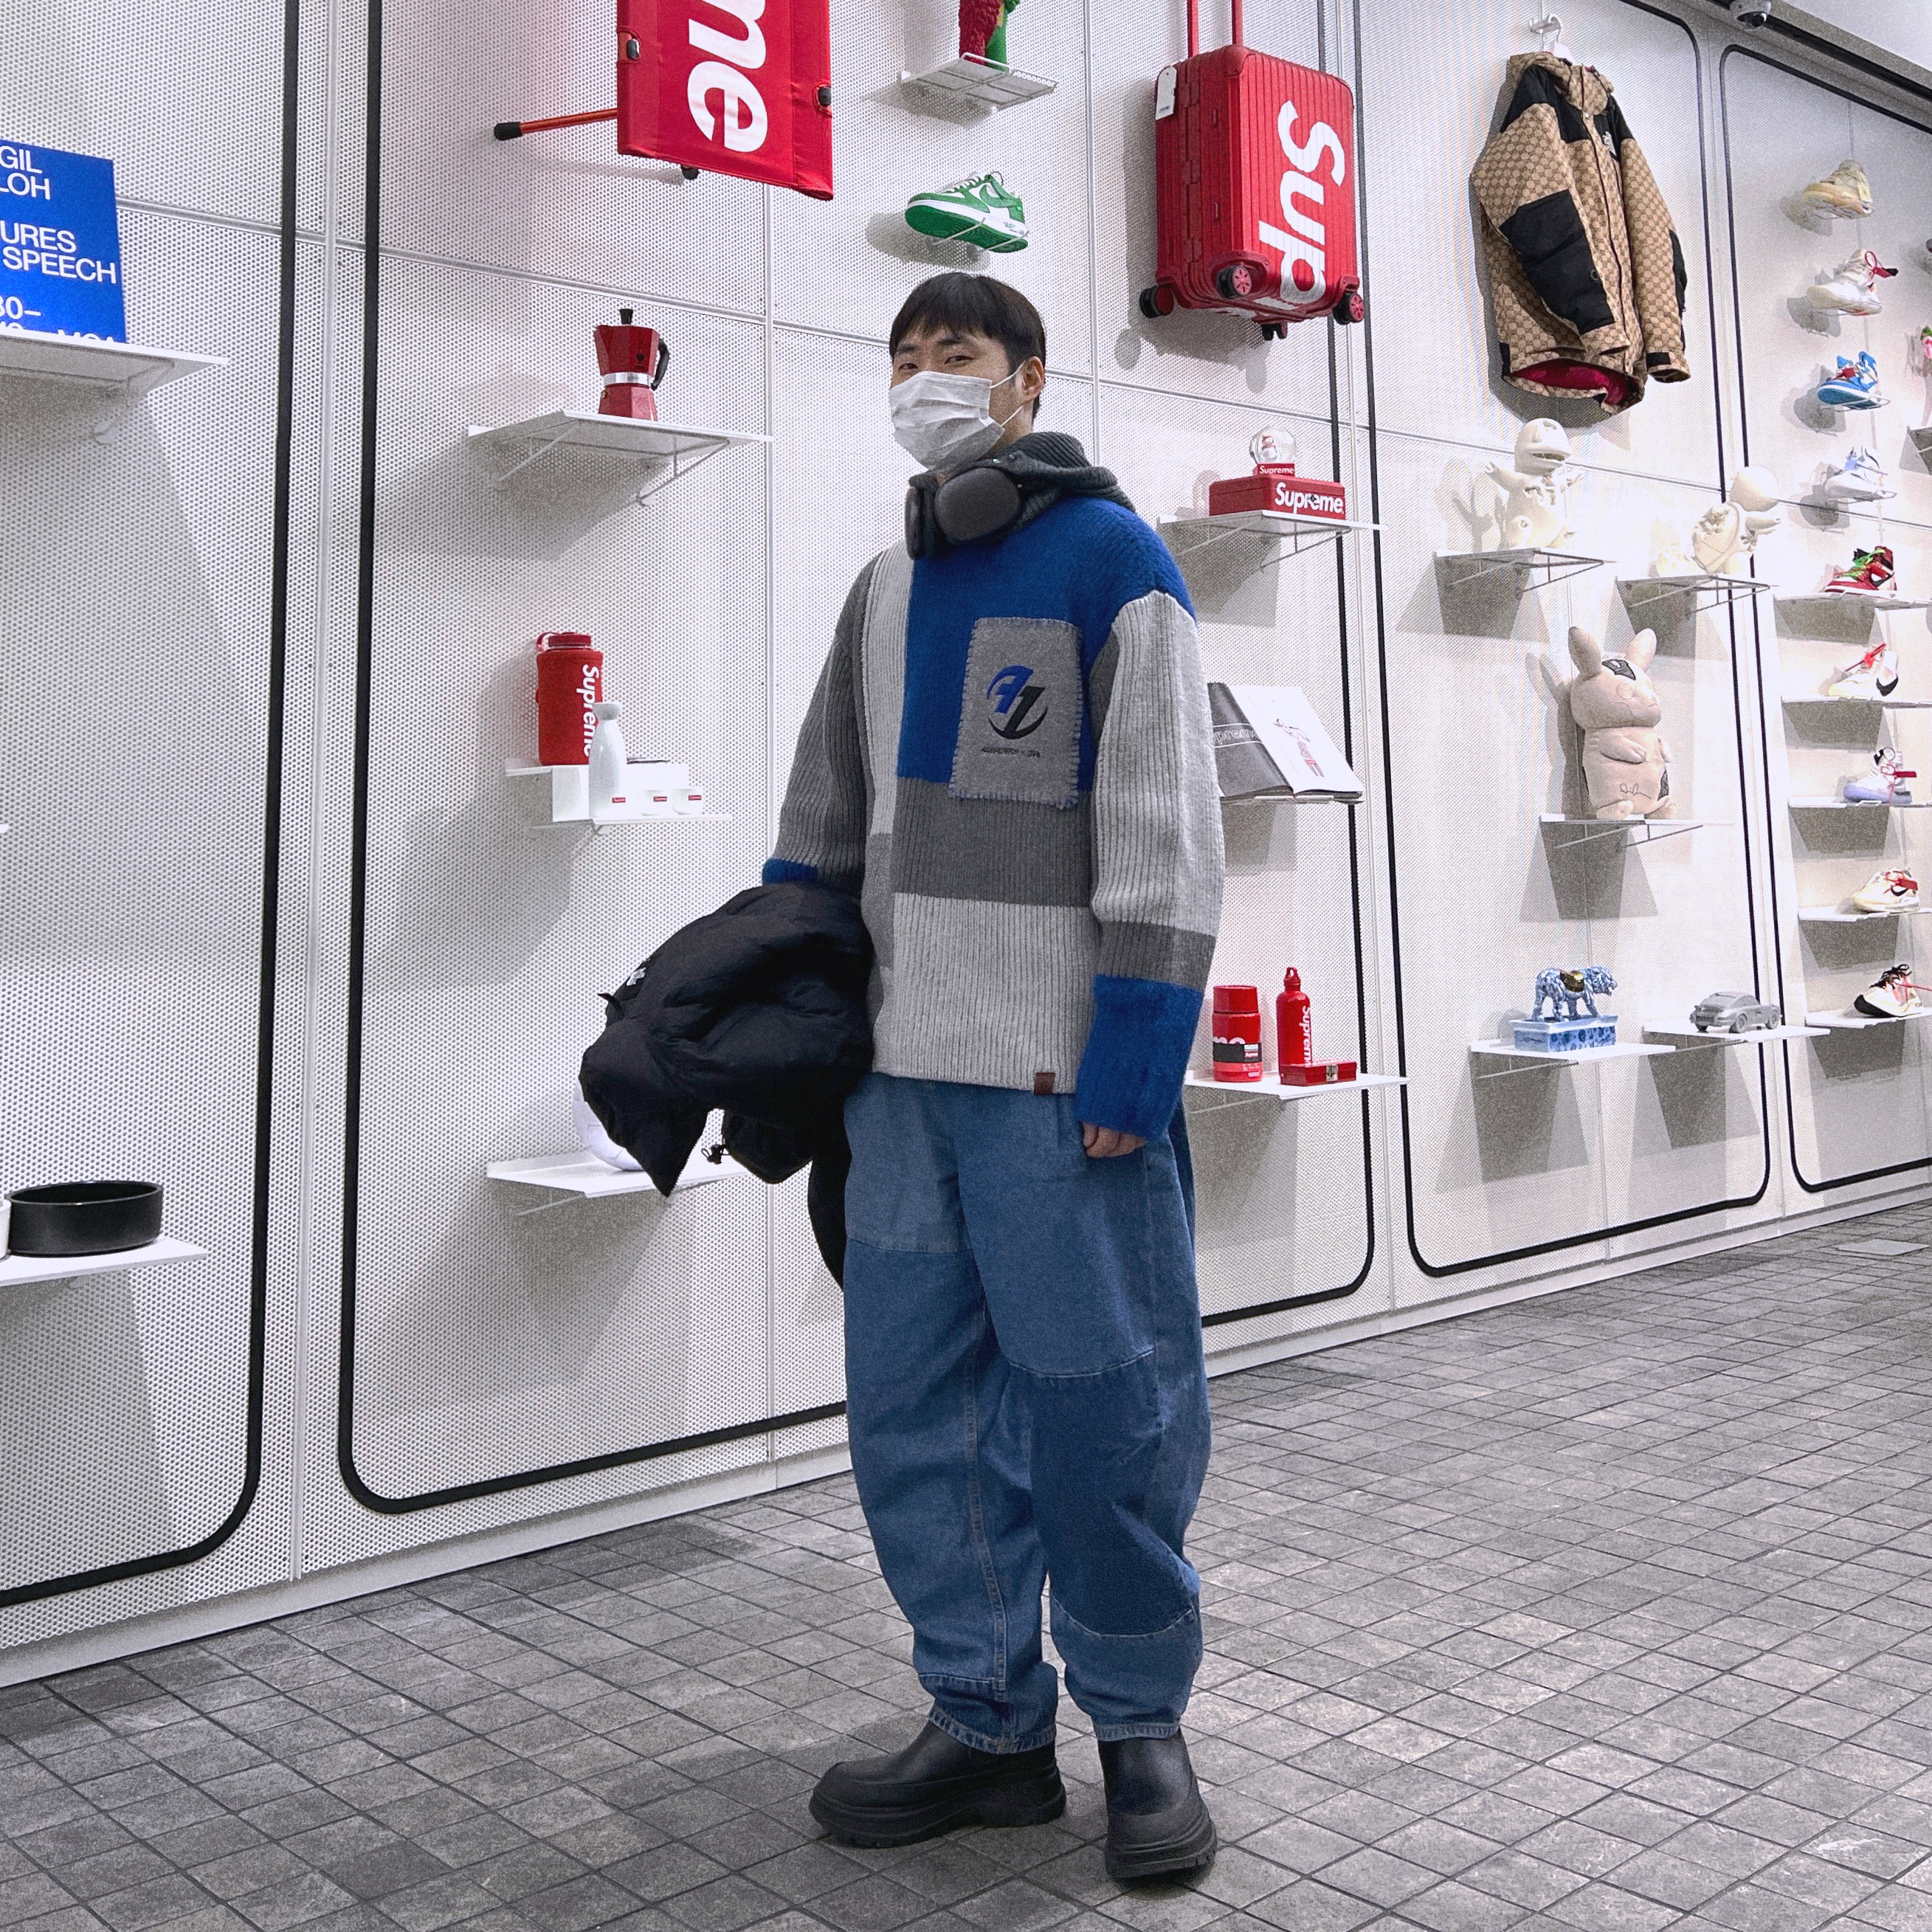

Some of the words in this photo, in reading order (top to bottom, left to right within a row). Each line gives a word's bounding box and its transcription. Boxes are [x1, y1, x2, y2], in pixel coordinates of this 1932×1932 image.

[0, 145, 42, 173] GIL
[0, 220, 77, 253] URES
[2, 246, 116, 284] SPEECH
[1259, 466, 1294, 474] Supreme
[1274, 482, 1343, 514] Supreme
[1299, 1006, 1311, 1063] Suprem
